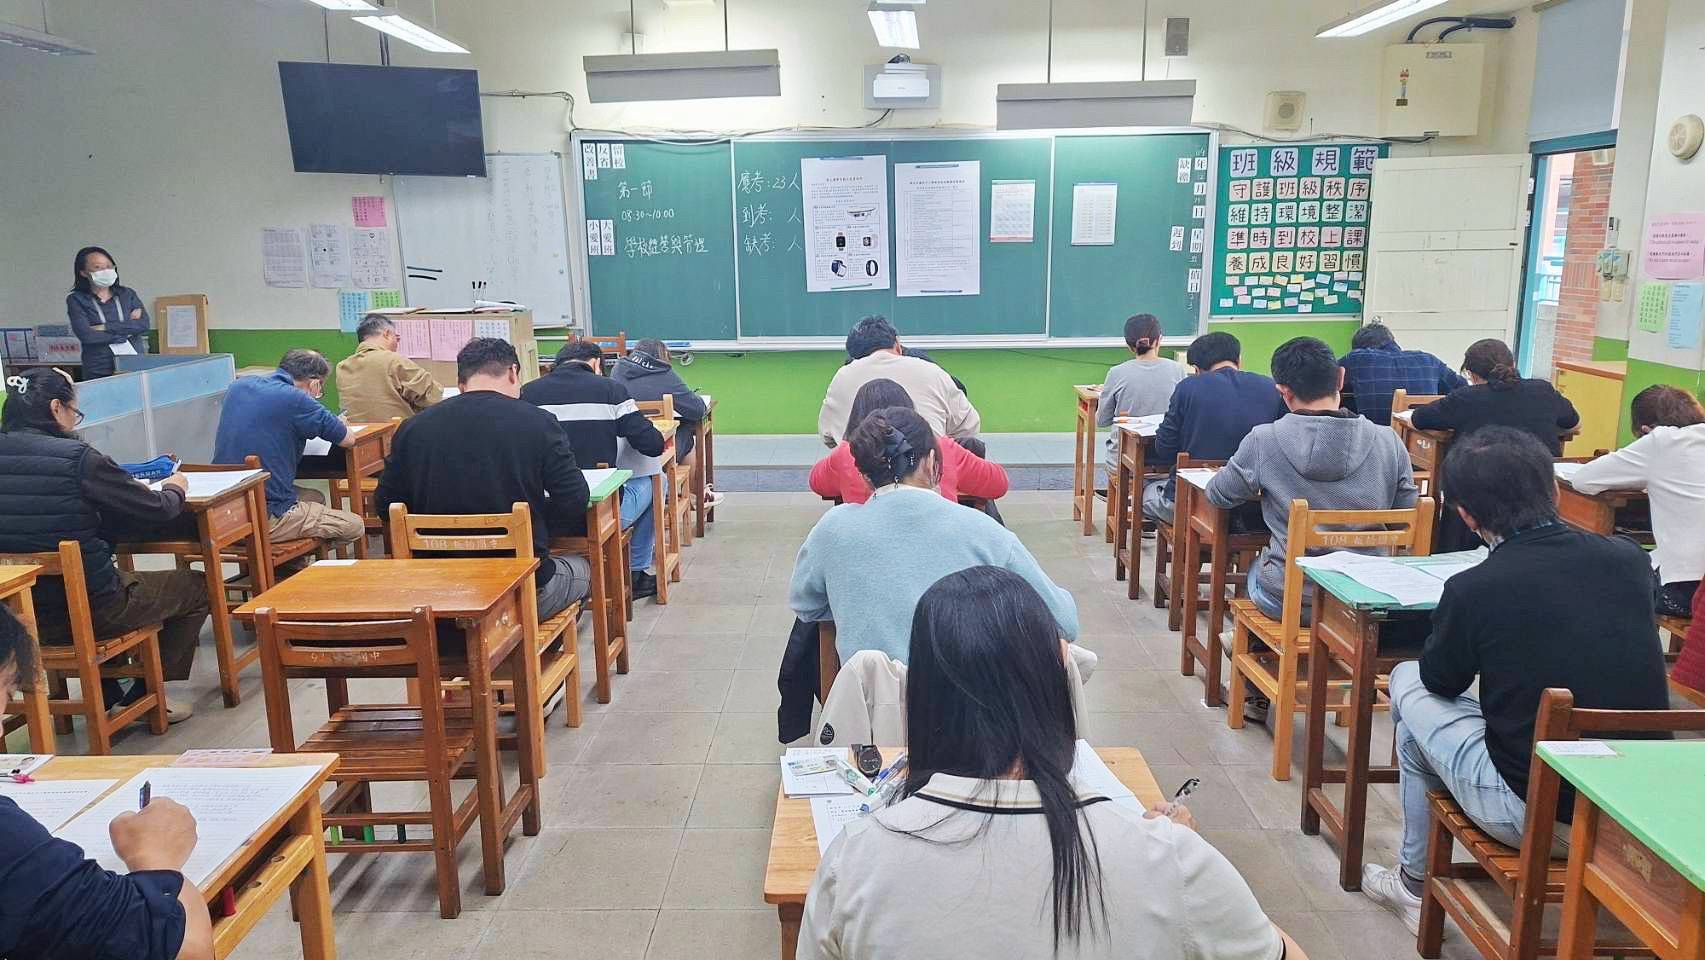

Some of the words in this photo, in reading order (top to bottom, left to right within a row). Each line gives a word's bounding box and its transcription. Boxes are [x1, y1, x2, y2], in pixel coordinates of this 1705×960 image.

[1232, 148, 1374, 174] 班級規範
[1232, 179, 1368, 199] 守護班級秩序
[1230, 203, 1366, 224] 維持環境整潔
[1229, 229, 1364, 248] 準時到校上課
[1228, 253, 1362, 272] 養成良好習慣
